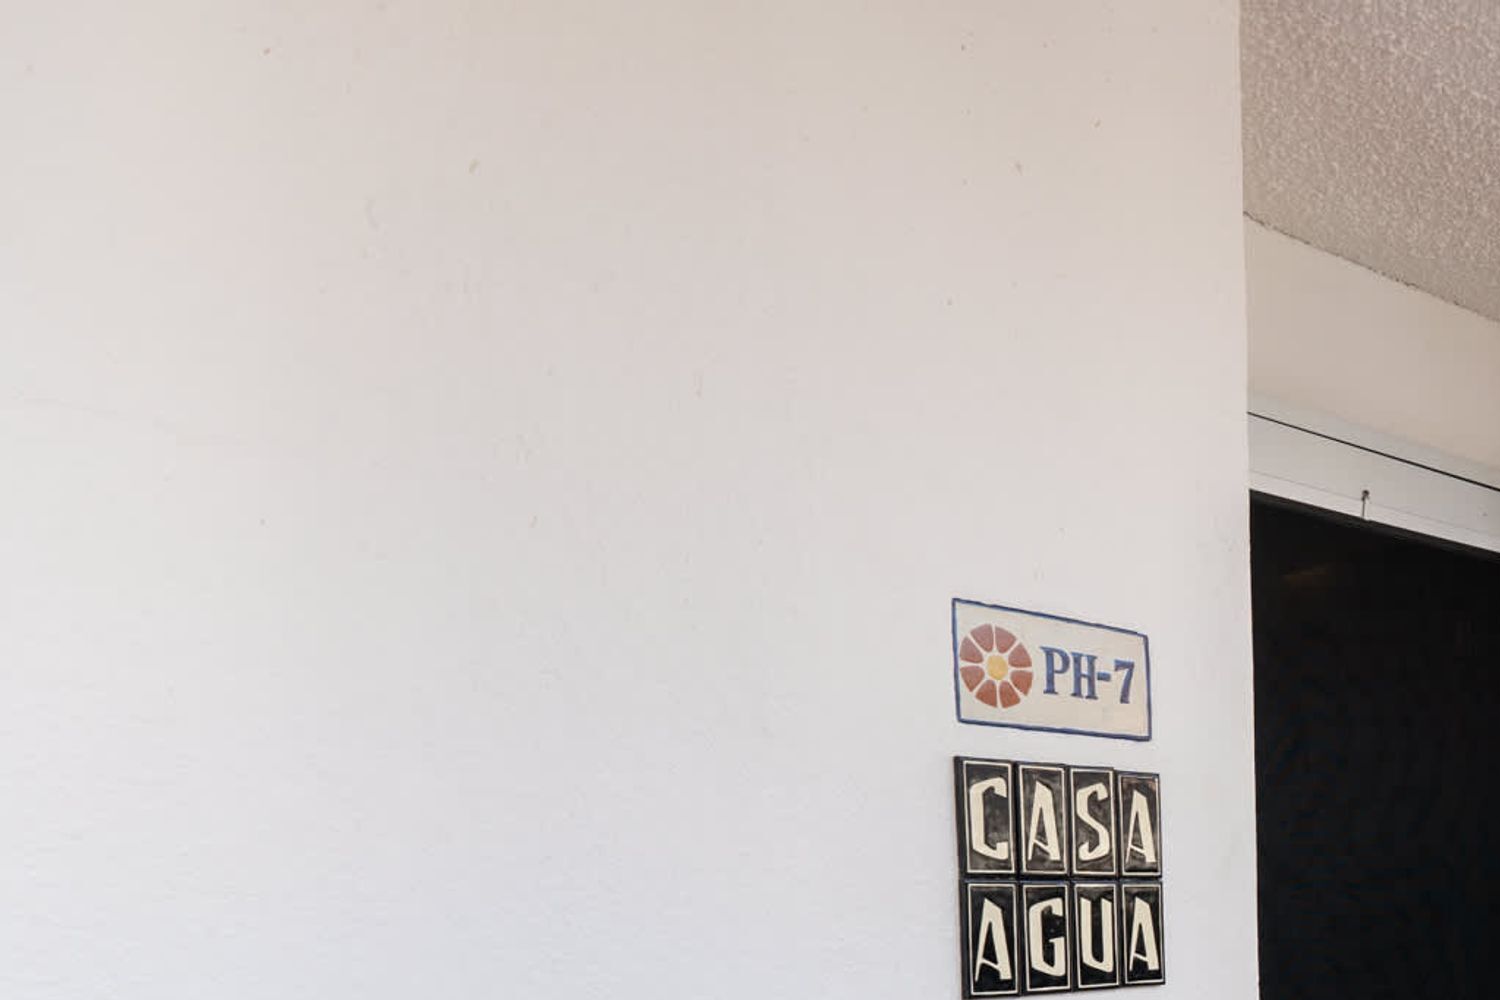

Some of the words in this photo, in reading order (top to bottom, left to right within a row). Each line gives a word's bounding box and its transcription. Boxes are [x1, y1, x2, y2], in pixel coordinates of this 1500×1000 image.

[1040, 645, 1135, 704] PH-7
[969, 776, 1155, 862] CASA
[975, 898, 1159, 981] AGUA
